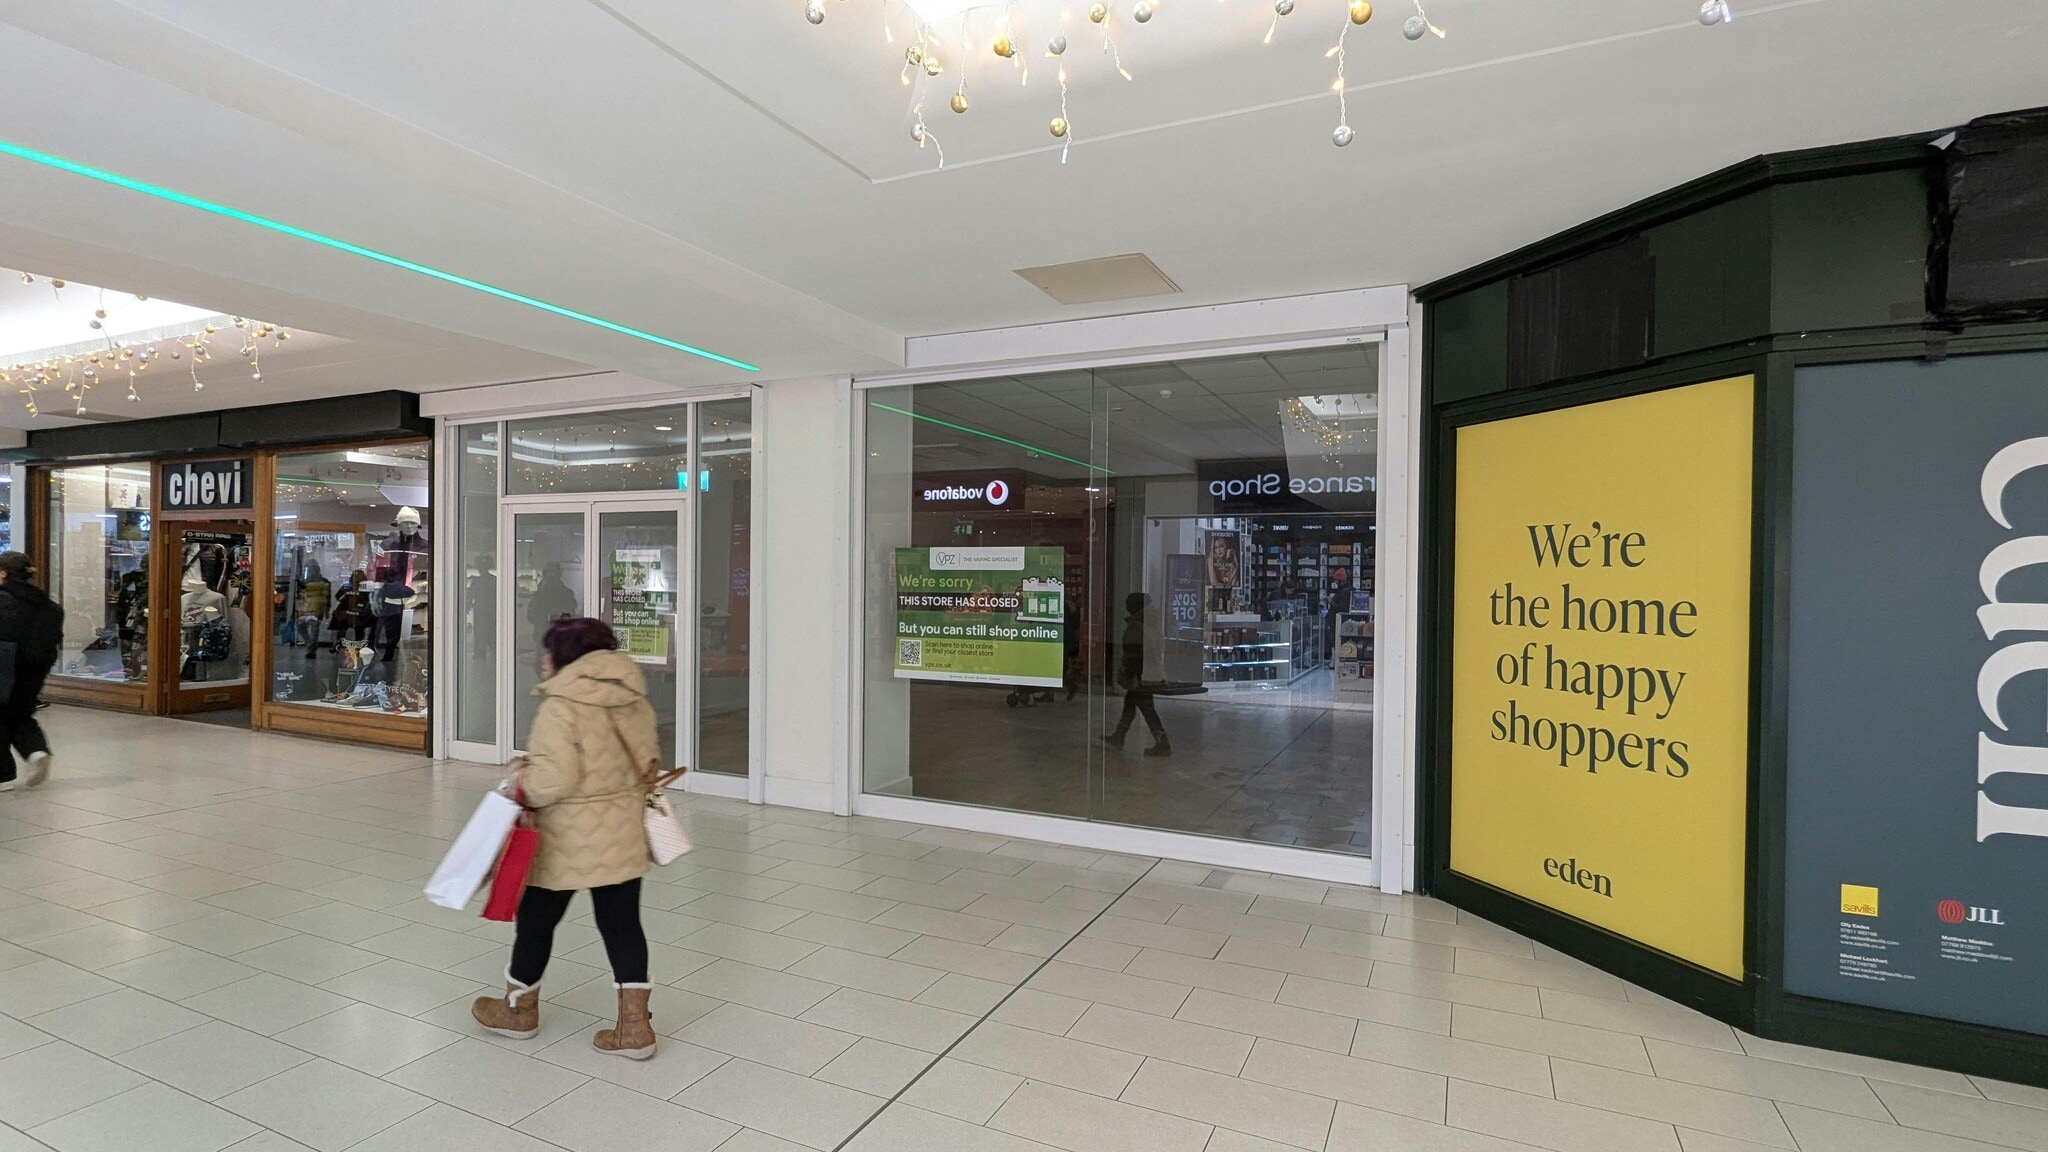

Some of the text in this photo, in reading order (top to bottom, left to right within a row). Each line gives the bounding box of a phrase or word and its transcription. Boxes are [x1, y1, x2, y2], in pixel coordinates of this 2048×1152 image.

[169, 461, 241, 506] chevi
[937, 553, 955, 565] VPZ
[899, 574, 974, 591] We're sorry
[899, 596, 1019, 608] THIS STORE HAS CLOSED
[1489, 582, 1698, 638] the home
[613, 608, 624, 617] But
[624, 611, 637, 619] you
[624, 617, 640, 626] shop
[641, 618, 660, 626] online
[899, 622, 1059, 640] But you can still shop online
[1496, 642, 1687, 720] of happy
[1490, 699, 1690, 778] shoppers
[1543, 857, 1613, 898] eden
[1842, 903, 1876, 916] savills
[1965, 906, 2005, 925] JLL
